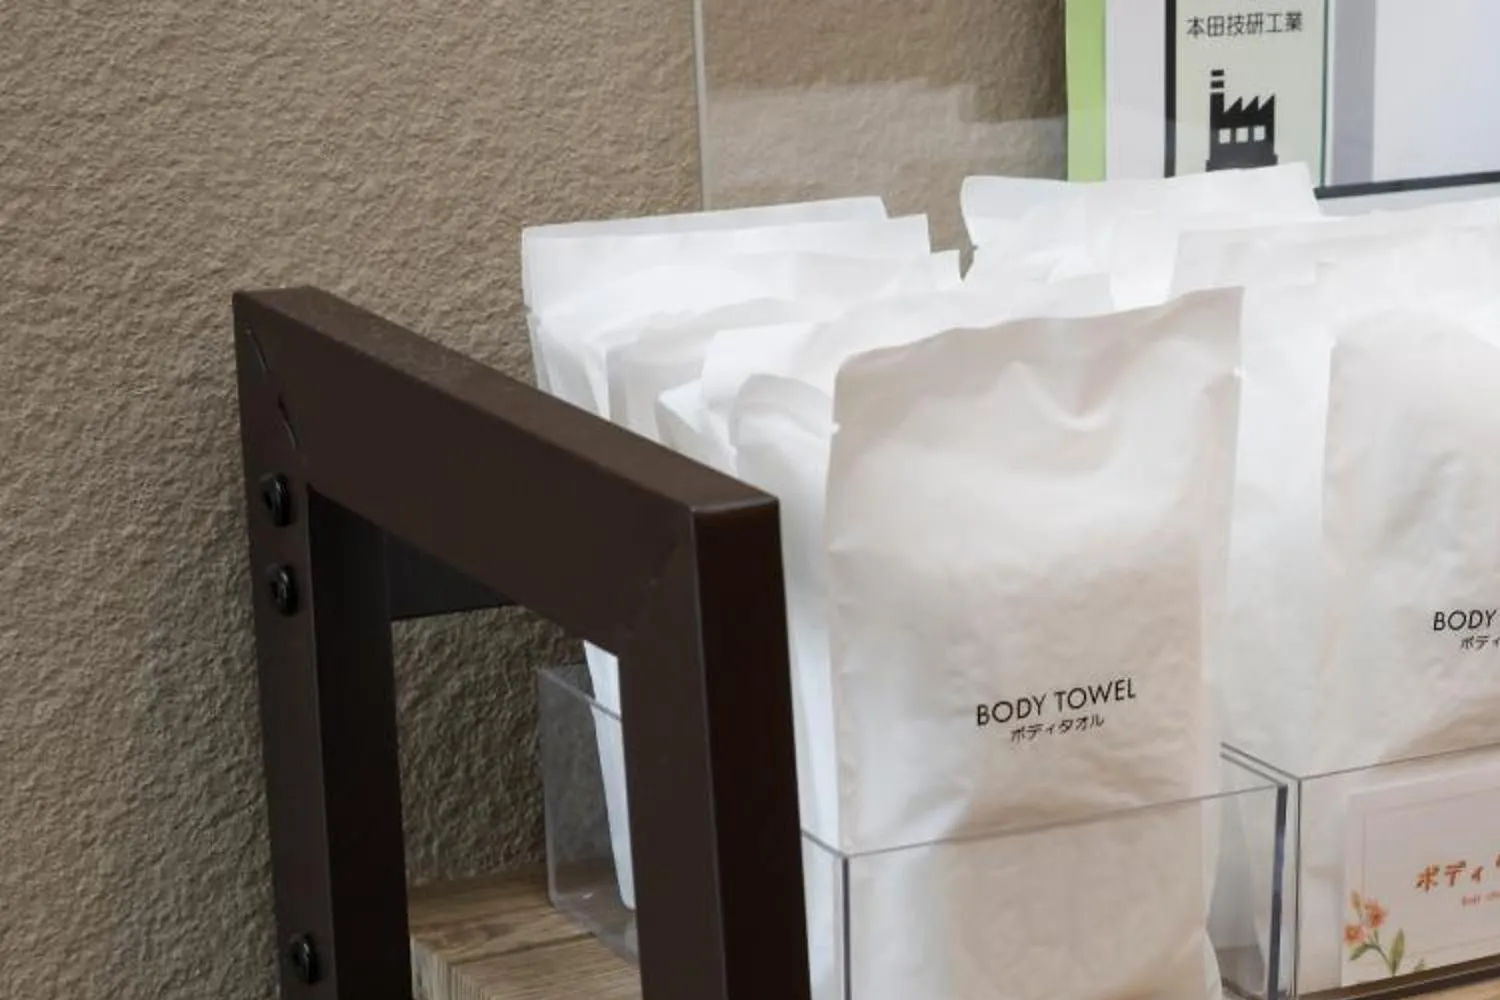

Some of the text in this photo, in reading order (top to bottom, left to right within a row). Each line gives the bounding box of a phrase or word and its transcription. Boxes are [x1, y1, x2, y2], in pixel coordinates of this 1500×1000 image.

[1185, 10, 1303, 39] 本田技研工業
[1433, 609, 1497, 632] BODY
[975, 680, 1137, 727] BODY TOWEL
[1009, 712, 1105, 744] ボディタオル
